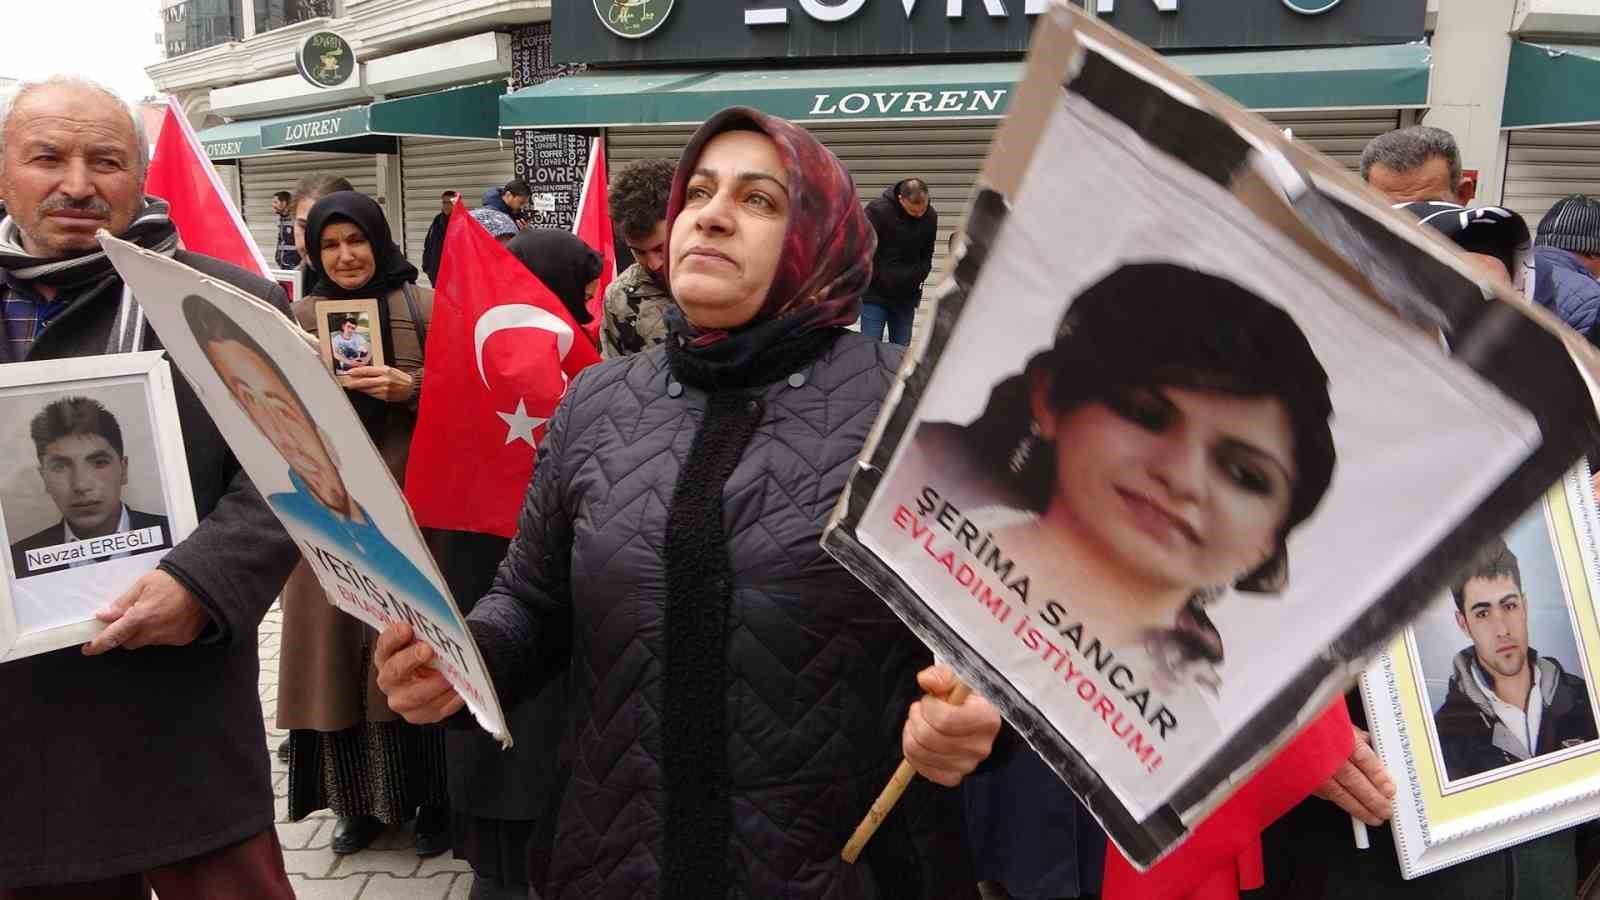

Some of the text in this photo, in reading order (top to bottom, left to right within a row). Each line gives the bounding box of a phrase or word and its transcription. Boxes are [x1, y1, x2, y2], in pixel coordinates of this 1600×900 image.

[285, 118, 341, 140] LOVREN
[809, 90, 1006, 115] LOVREN
[28, 544, 85, 568] Nevzat
[386, 592, 469, 674] MERT
[893, 505, 1163, 773] EVLADIMI İSTİYORUM!
[916, 486, 1178, 741] ŞERİMA SANCAR
